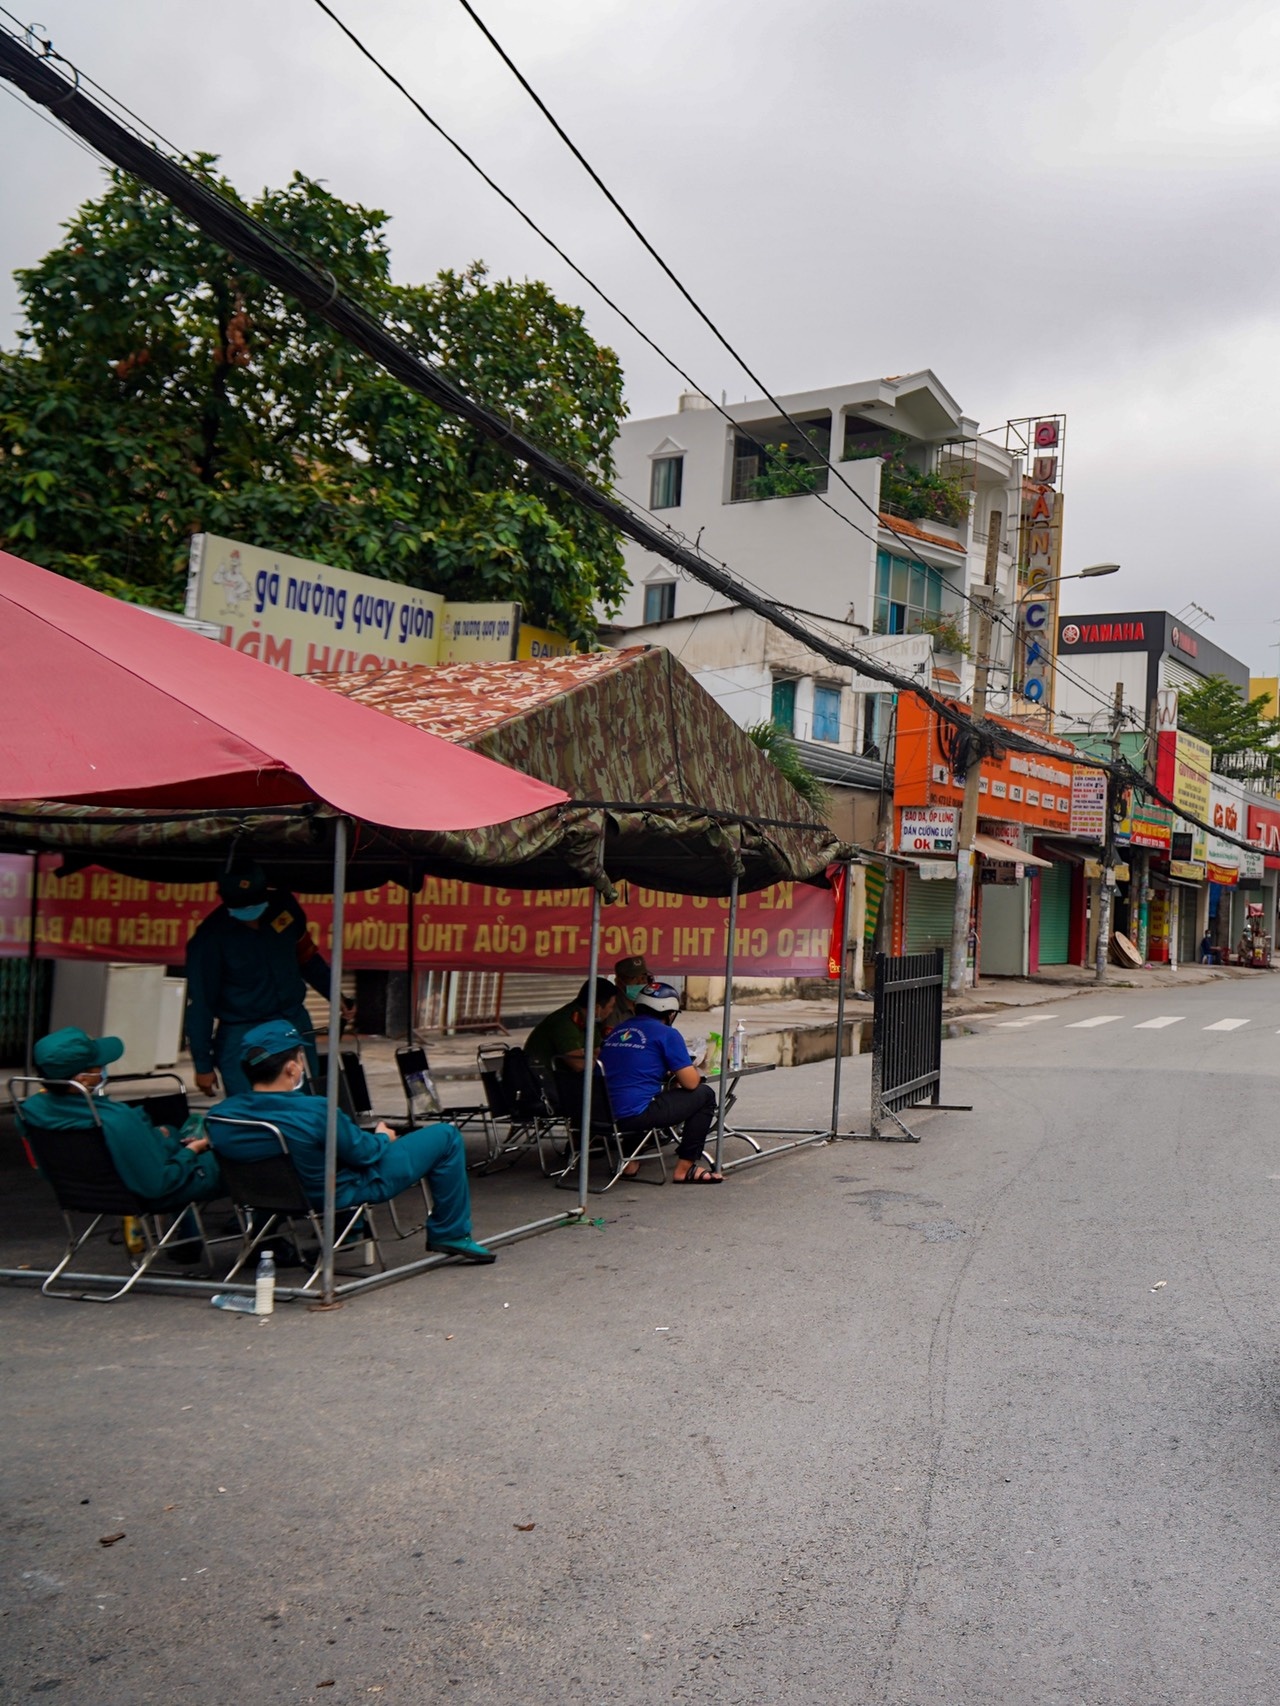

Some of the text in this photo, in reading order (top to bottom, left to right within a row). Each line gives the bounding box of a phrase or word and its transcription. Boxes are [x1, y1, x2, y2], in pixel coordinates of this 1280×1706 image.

[353, 593, 395, 640] quay
[1081, 622, 1145, 643] YAMAHA
[914, 839, 931, 850] Ok
